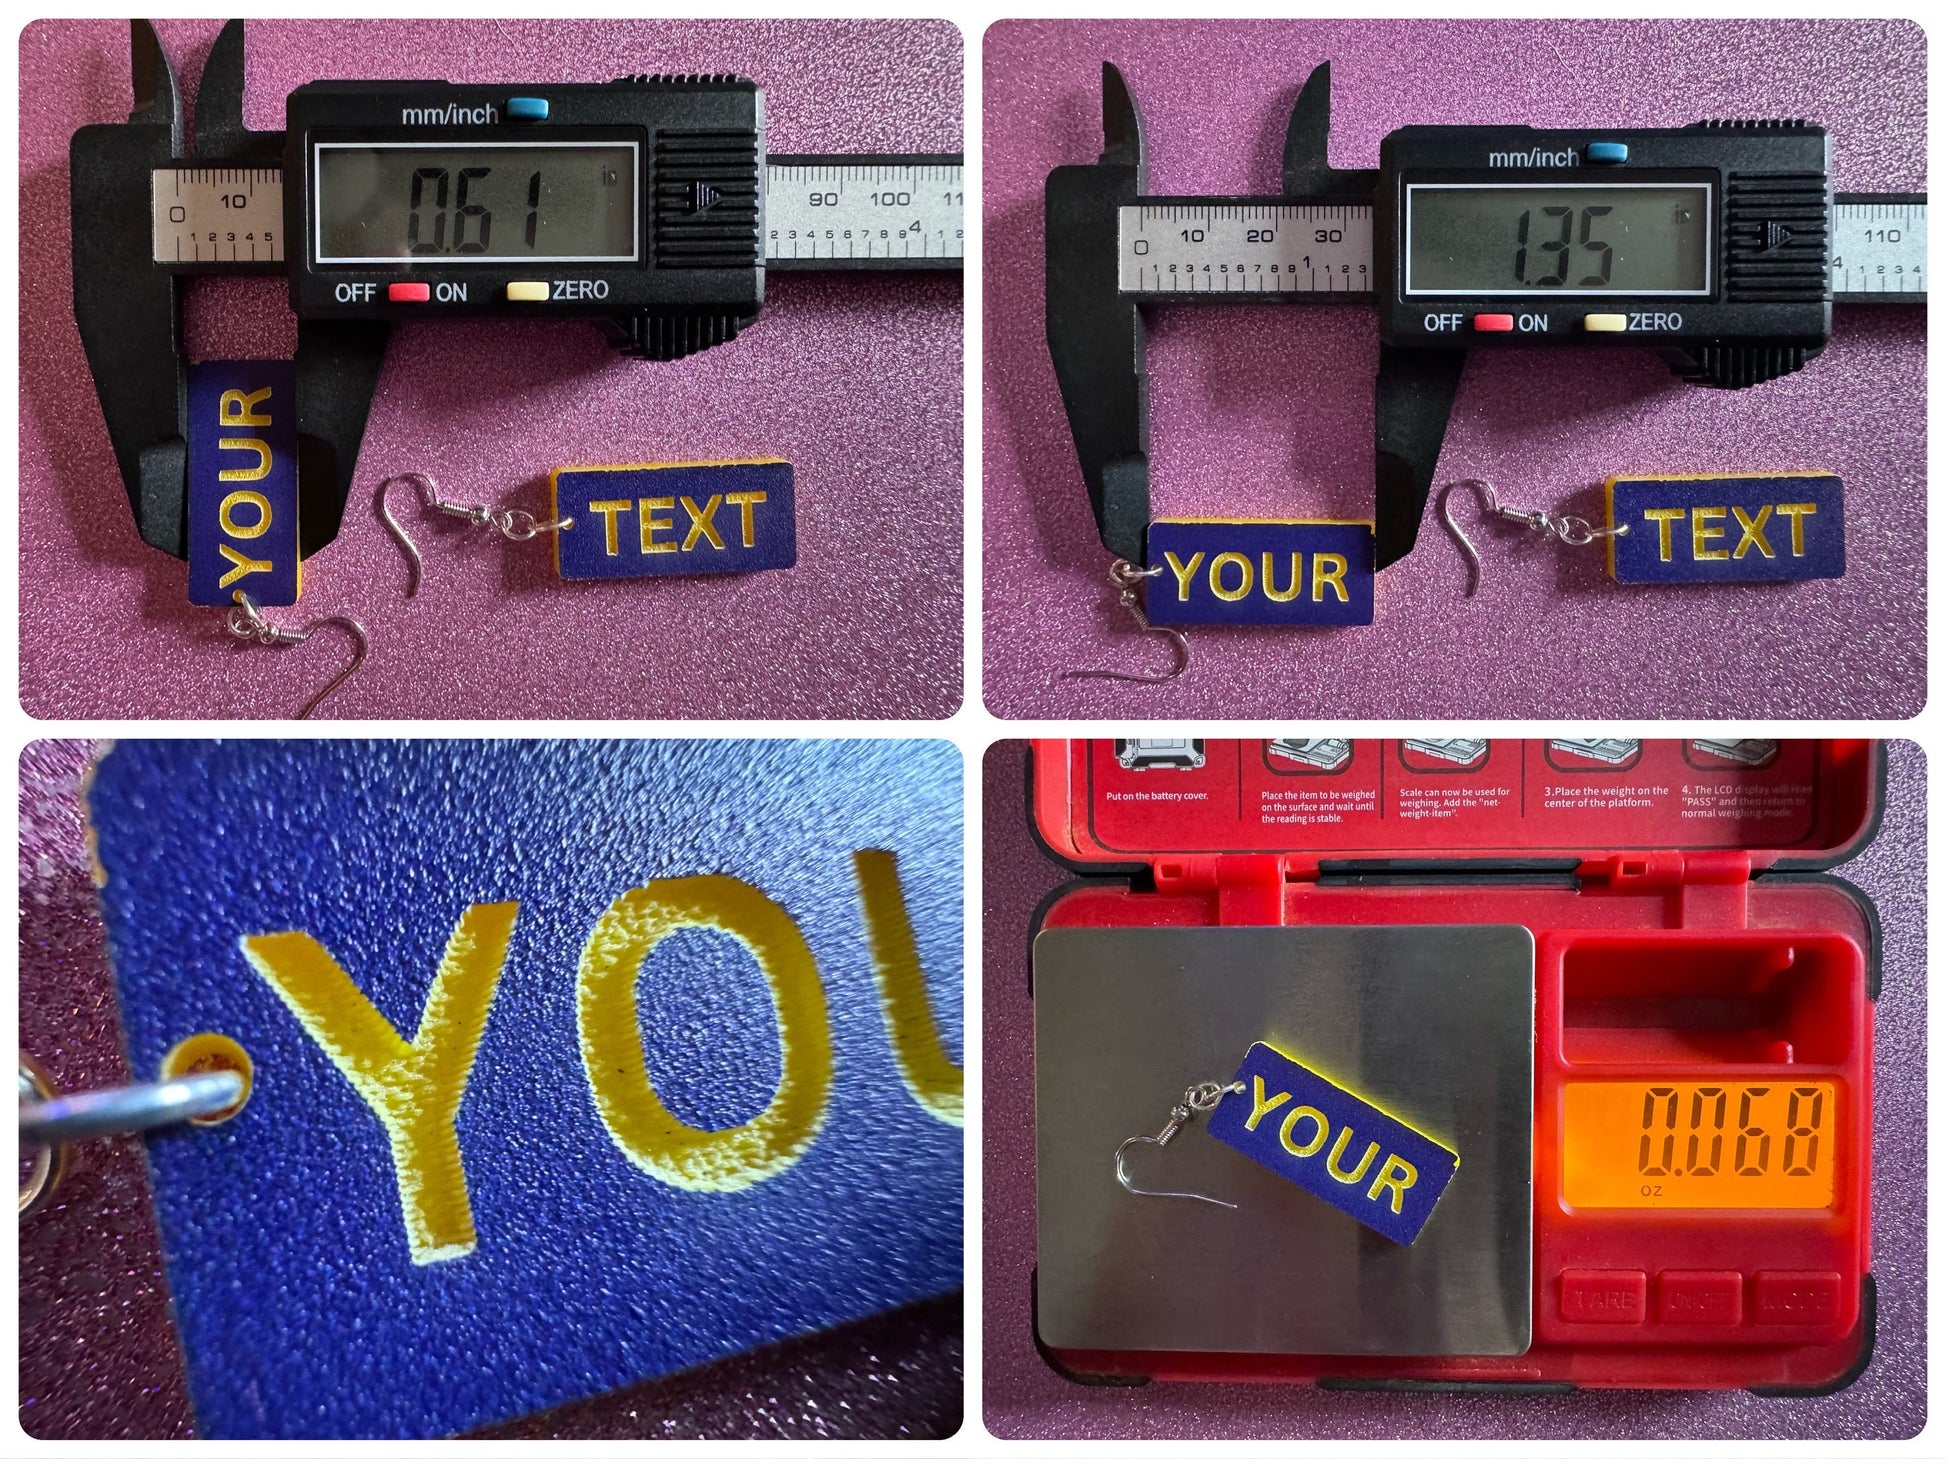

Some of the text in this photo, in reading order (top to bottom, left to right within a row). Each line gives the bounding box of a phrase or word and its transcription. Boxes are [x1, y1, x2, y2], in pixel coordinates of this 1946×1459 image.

[402, 103, 499, 125] mm/inch
[1489, 147, 1580, 168] mm/inch
[221, 194, 247, 209] 10
[809, 192, 838, 206] 90
[870, 192, 911, 206] 100
[169, 206, 186, 223] 0
[408, 168, 540, 253] 0.61
[190, 232, 273, 242] 1 2 3 4 5
[770, 230, 779, 239] 2
[789, 230, 797, 239] 3
[807, 230, 815, 239] 4
[826, 230, 834, 239] 5
[844, 230, 852, 239] 6
[862, 230, 870, 239] 7
[880, 230, 888, 239] 8
[899, 230, 907, 239] 9
[909, 220, 921, 234] 4
[1180, 229, 1342, 243] 10 20 30
[1864, 229, 1901, 243] 110
[1134, 240, 1149, 255] 0
[1515, 206, 1613, 286] 1.35
[1153, 256, 1366, 273] 1 2 3 4 5 6 7 8 9 1 1 2 3
[1833, 256, 1921, 274] 4 1 2 3 4
[335, 283, 377, 302] OFF
[436, 282, 467, 302] ON
[552, 280, 609, 300] ZERO
[1424, 314, 1463, 331] OFF
[1518, 313, 1548, 332] ON
[1629, 312, 1683, 331] ZERO
[218, 386, 273, 589] YOUR
[589, 491, 767, 556] TEXT
[1644, 503, 1817, 562] TEXT
[1164, 551, 1349, 602] YOUR
[1106, 792, 1121, 800] Put
[1135, 792, 1150, 800] the
[1151, 791, 1182, 802] battery
[1261, 790, 1376, 801] Place the item to be weighed
[1400, 788, 1422, 796] Scale
[1462, 788, 1473, 796] be
[1475, 787, 1495, 796] used
[1497, 787, 1510, 795] for
[1583, 786, 1599, 796] the
[1601, 786, 1635, 797] weight
[1652, 786, 1669, 795] the
[1681, 785, 1691, 794] 4.
[1694, 785, 1712, 794] The
[1714, 785, 1733, 794] LCD
[1273, 803, 1287, 811] the
[1288, 802, 1317, 811] surface
[1319, 802, 1334, 811] and
[1336, 802, 1353, 811] wait
[1355, 801, 1374, 811] until
[1400, 799, 1441, 808] weighing.
[1544, 797, 1655, 808] center of the platform.
[1681, 797, 1717, 806] "PASS"
[1718, 797, 1737, 806] and
[1739, 797, 1761, 805] then
[1261, 813, 1344, 825] the reading is stable.
[1681, 808, 1716, 818] normal
[1717, 808, 1762, 819] weighing
[1638, 1087, 1823, 1177] 0.068
[1244, 1074, 1418, 1214] YOUR
[1575, 1291, 1635, 1310] TARE
